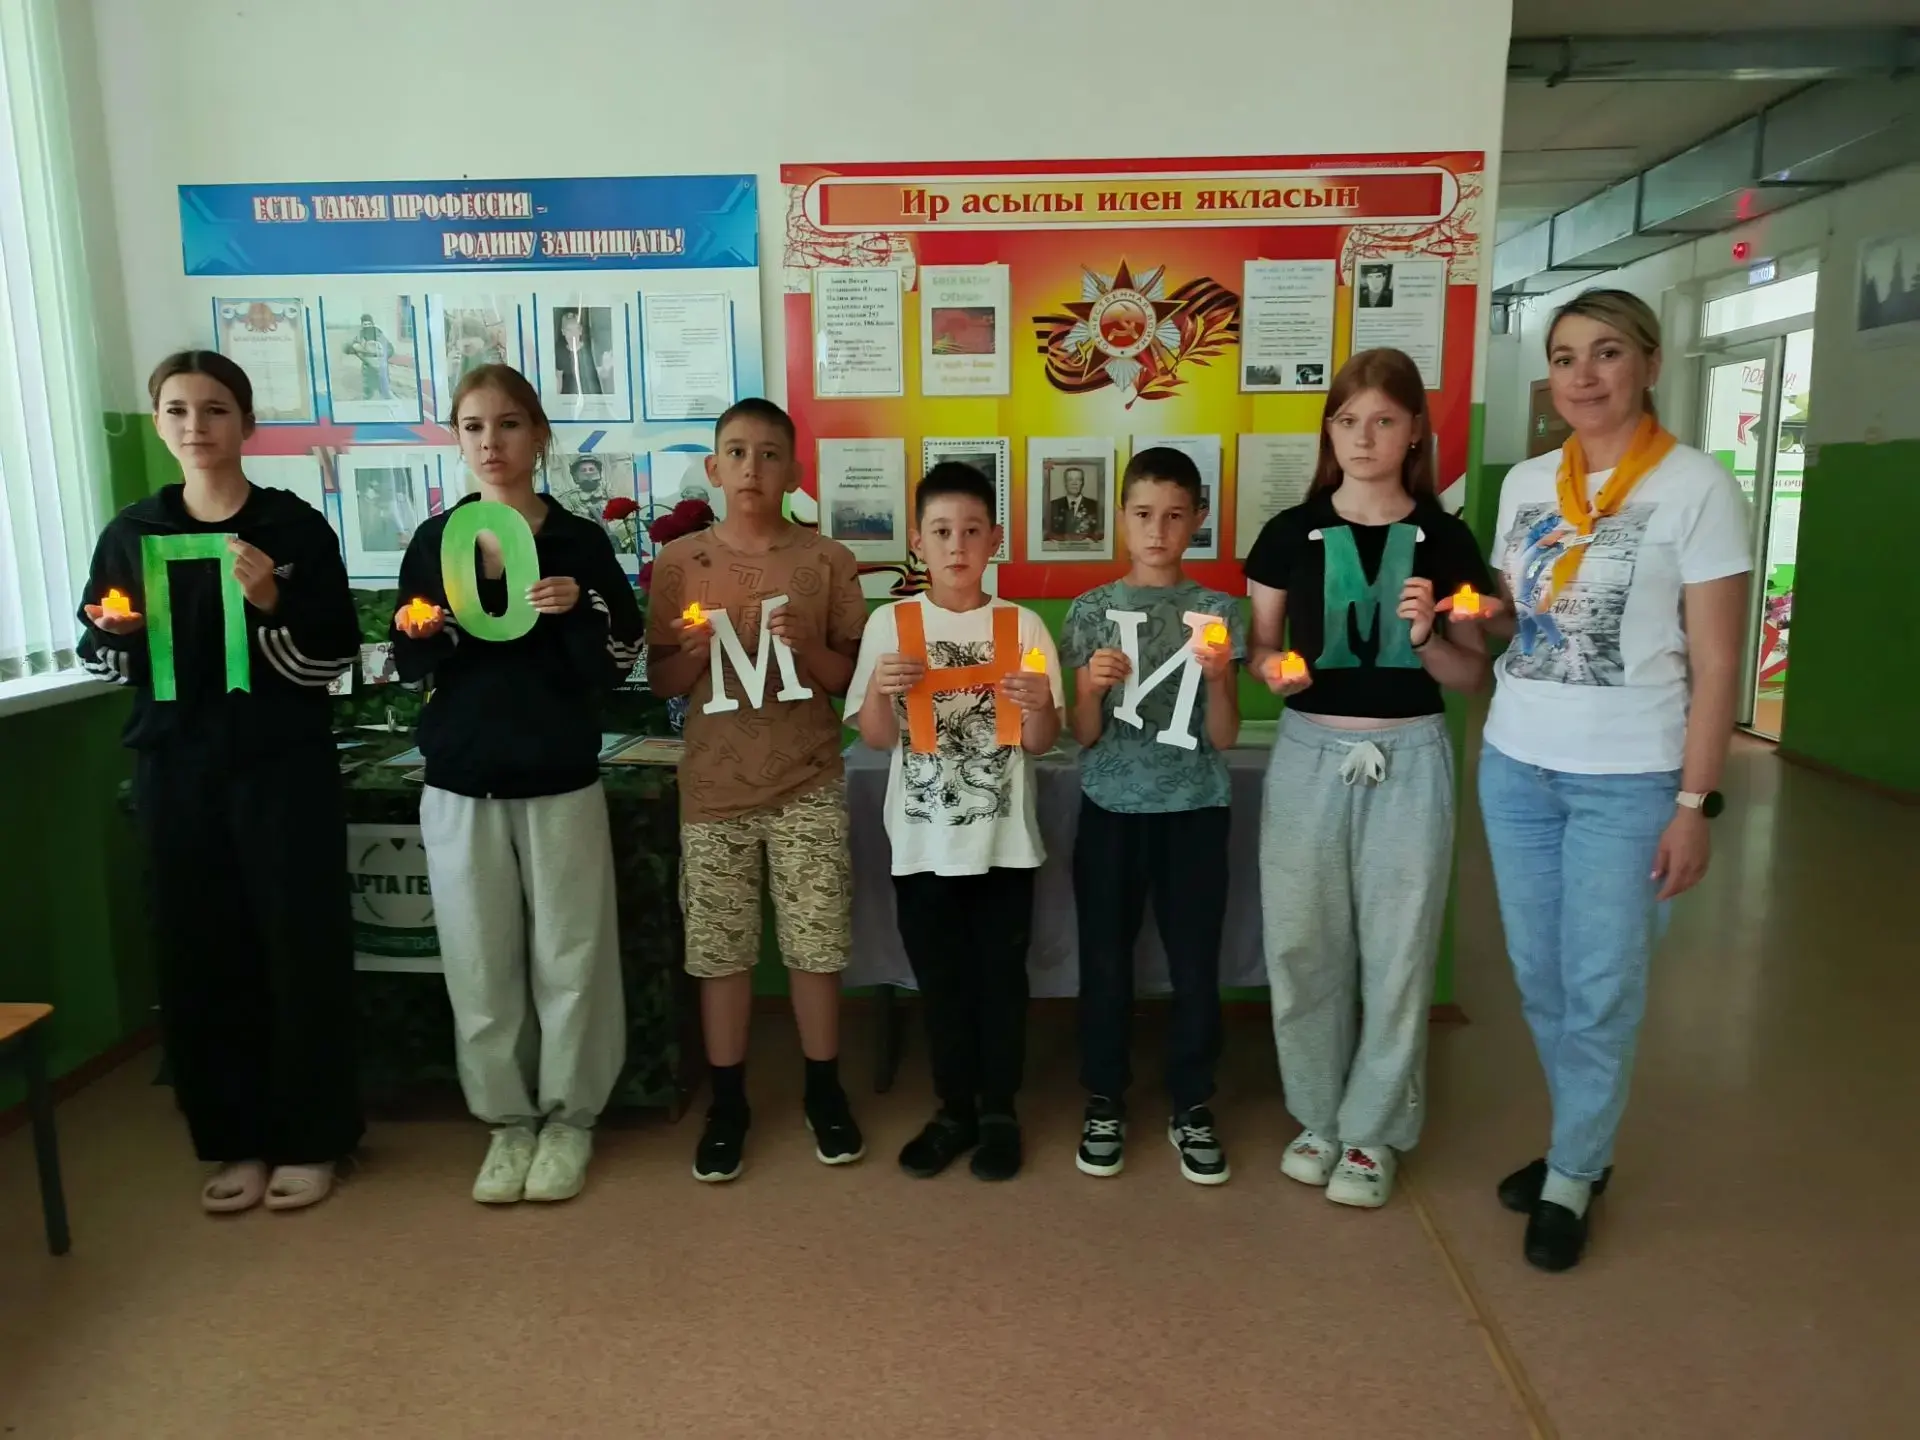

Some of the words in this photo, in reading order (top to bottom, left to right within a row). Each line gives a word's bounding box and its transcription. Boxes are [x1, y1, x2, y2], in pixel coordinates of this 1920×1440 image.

[253, 195, 309, 223] ЕСТЬ
[312, 194, 390, 222] ТАКАЯ
[392, 192, 533, 221] ПРОФЕССИЯ
[902, 189, 950, 222] Ир
[961, 192, 1083, 214] асылы
[1097, 190, 1182, 211] илен
[1195, 186, 1359, 211] якласын
[442, 231, 537, 261] РОДИНУ
[541, 228, 686, 260] ЗАЩИЩАТЬ!
